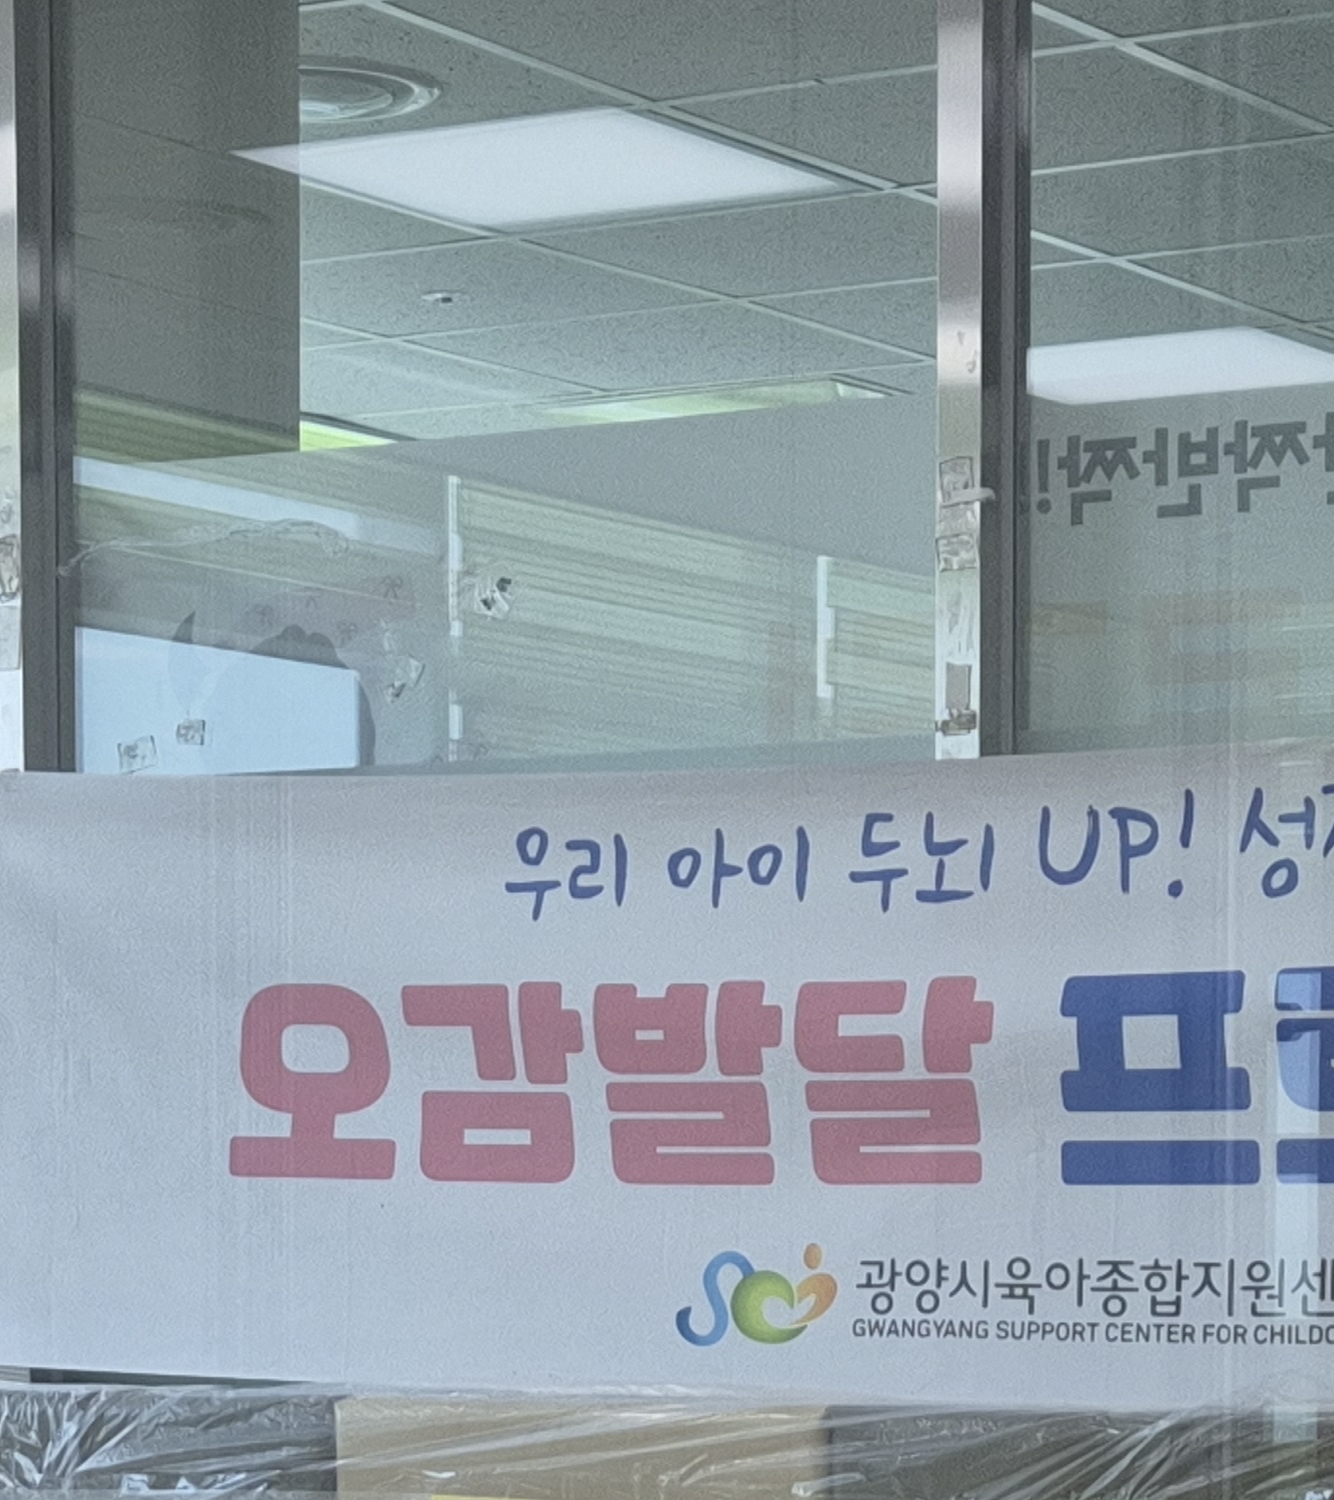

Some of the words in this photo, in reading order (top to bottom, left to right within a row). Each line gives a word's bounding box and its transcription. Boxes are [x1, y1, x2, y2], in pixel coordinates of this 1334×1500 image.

[504, 827, 629, 922] 우리
[667, 825, 810, 907] 아이
[849, 812, 995, 911] 두뇌
[1037, 790, 1196, 897] UP!
[229, 976, 995, 1185] 오감발달
[852, 1318, 989, 1339] GWANGYANG
[995, 1319, 1100, 1343] SUPPORT
[1105, 1321, 1196, 1344] CENTER
[1202, 1323, 1248, 1345] FOR
